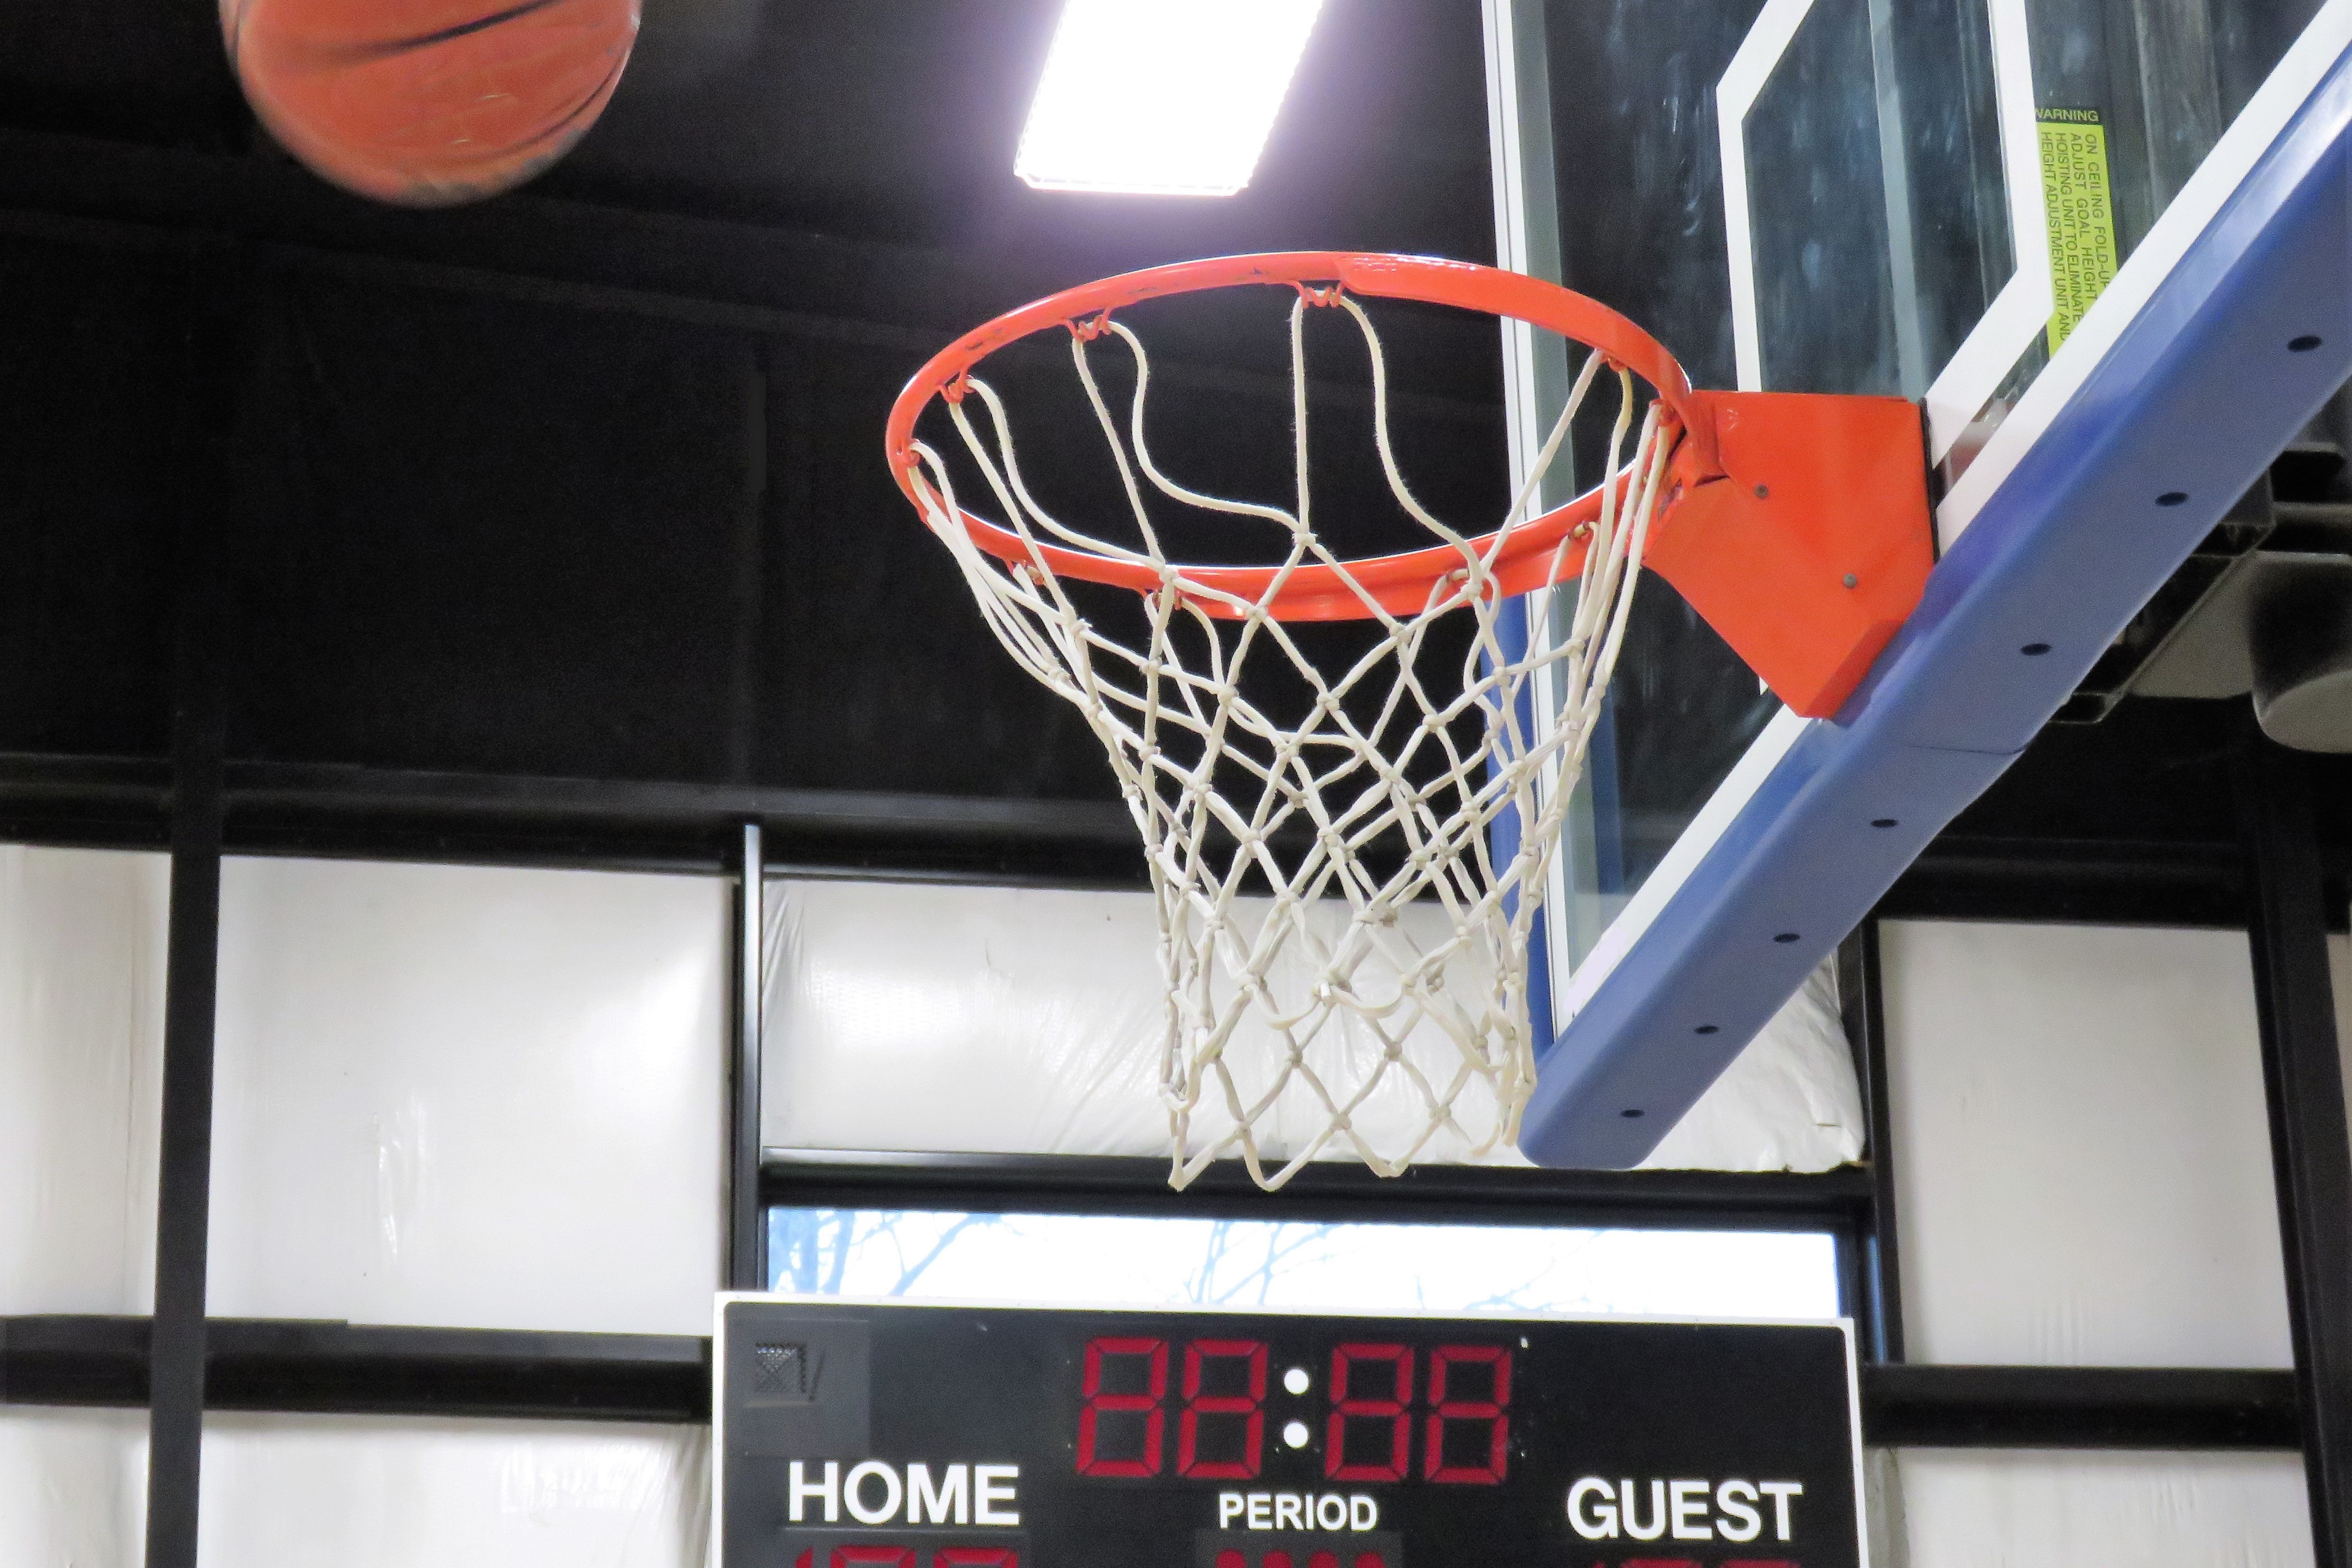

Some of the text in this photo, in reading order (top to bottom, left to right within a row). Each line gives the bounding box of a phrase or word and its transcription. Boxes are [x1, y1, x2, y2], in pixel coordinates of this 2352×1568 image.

[2042, 131, 2056, 181] HEIGHT
[2056, 133, 2072, 195] HOISTING
[2085, 134, 2098, 155] ON
[2062, 199, 2076, 229] UNIT
[2071, 133, 2098, 300] ADJUST GOAL HEIGHT
[2087, 162, 2104, 218] CEILING
[2046, 184, 2065, 274] ADJUSTMENT
[2065, 233, 2077, 251] TO
[2055, 277, 2069, 309] UNIT
[788, 1460, 1020, 1526] HOME
[1218, 1493, 1378, 1532] PERIOD
[1566, 1476, 1803, 1542] GUEST
